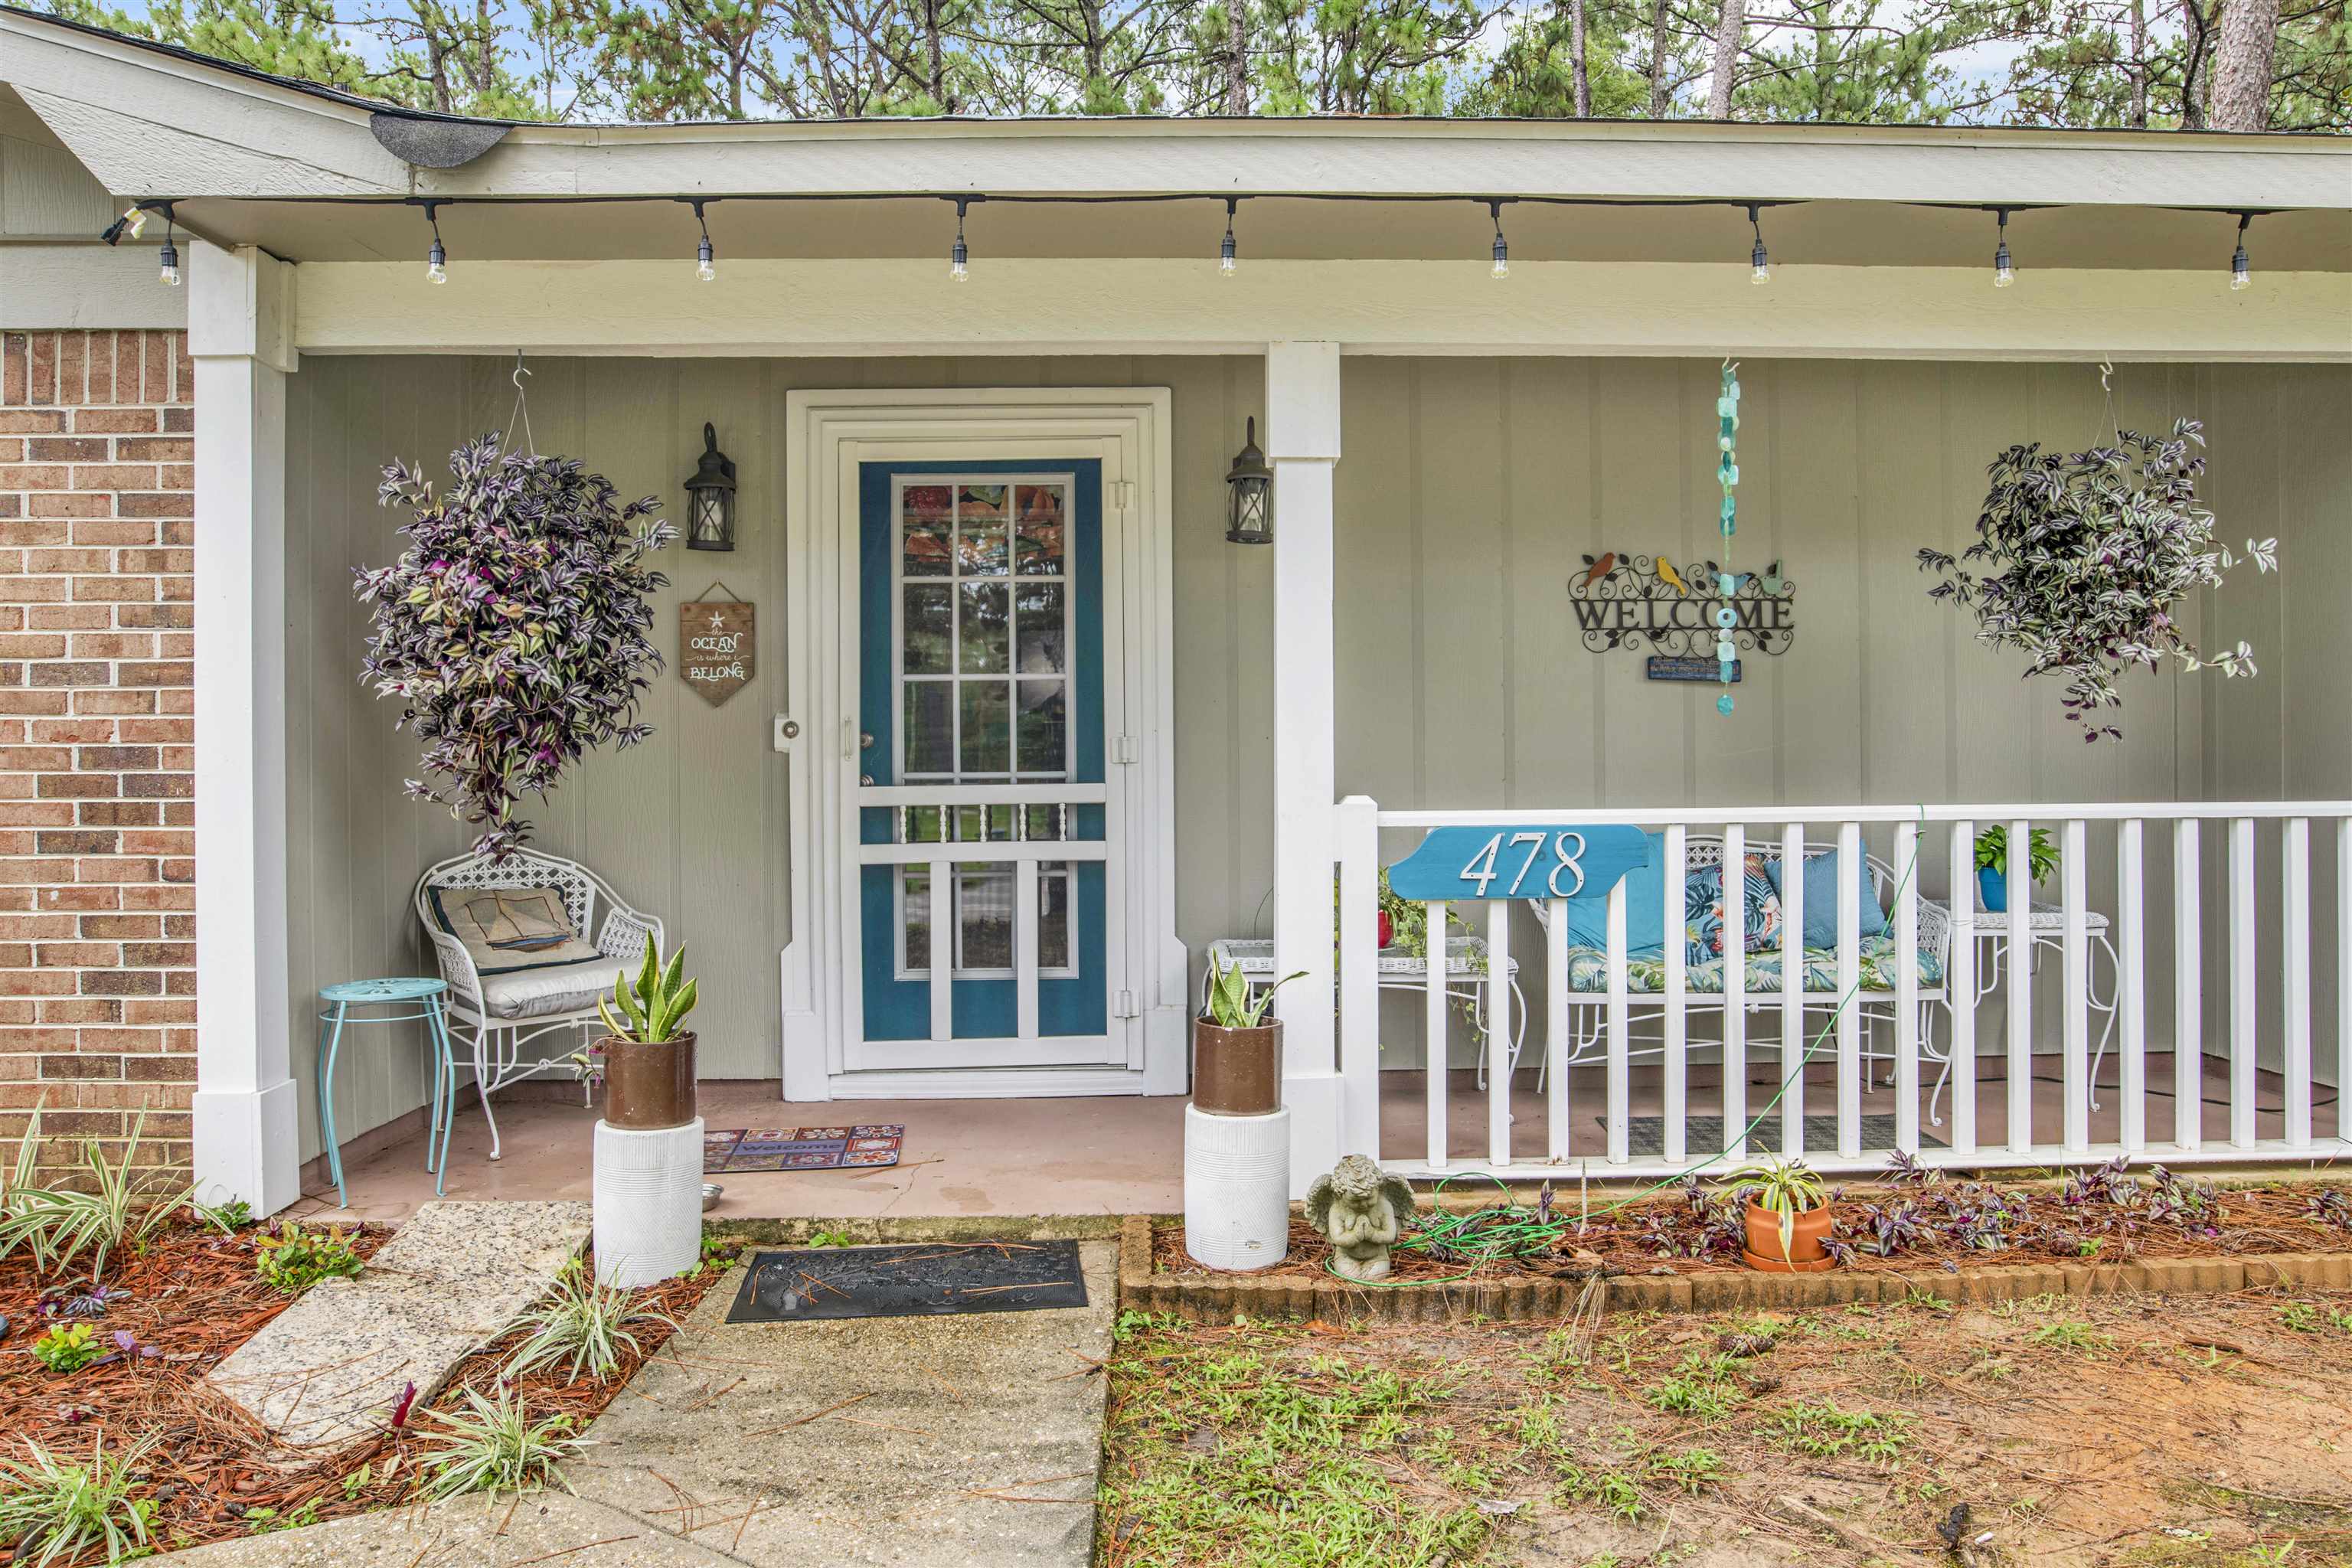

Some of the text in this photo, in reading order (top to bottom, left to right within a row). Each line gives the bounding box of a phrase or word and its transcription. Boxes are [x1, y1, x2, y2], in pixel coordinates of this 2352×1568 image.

[1570, 599, 1795, 631] WELCOME
[691, 632, 743, 652] OCEAN
[705, 651, 732, 662] where
[690, 662, 745, 681] BELONG
[1459, 831, 1586, 898] 478
